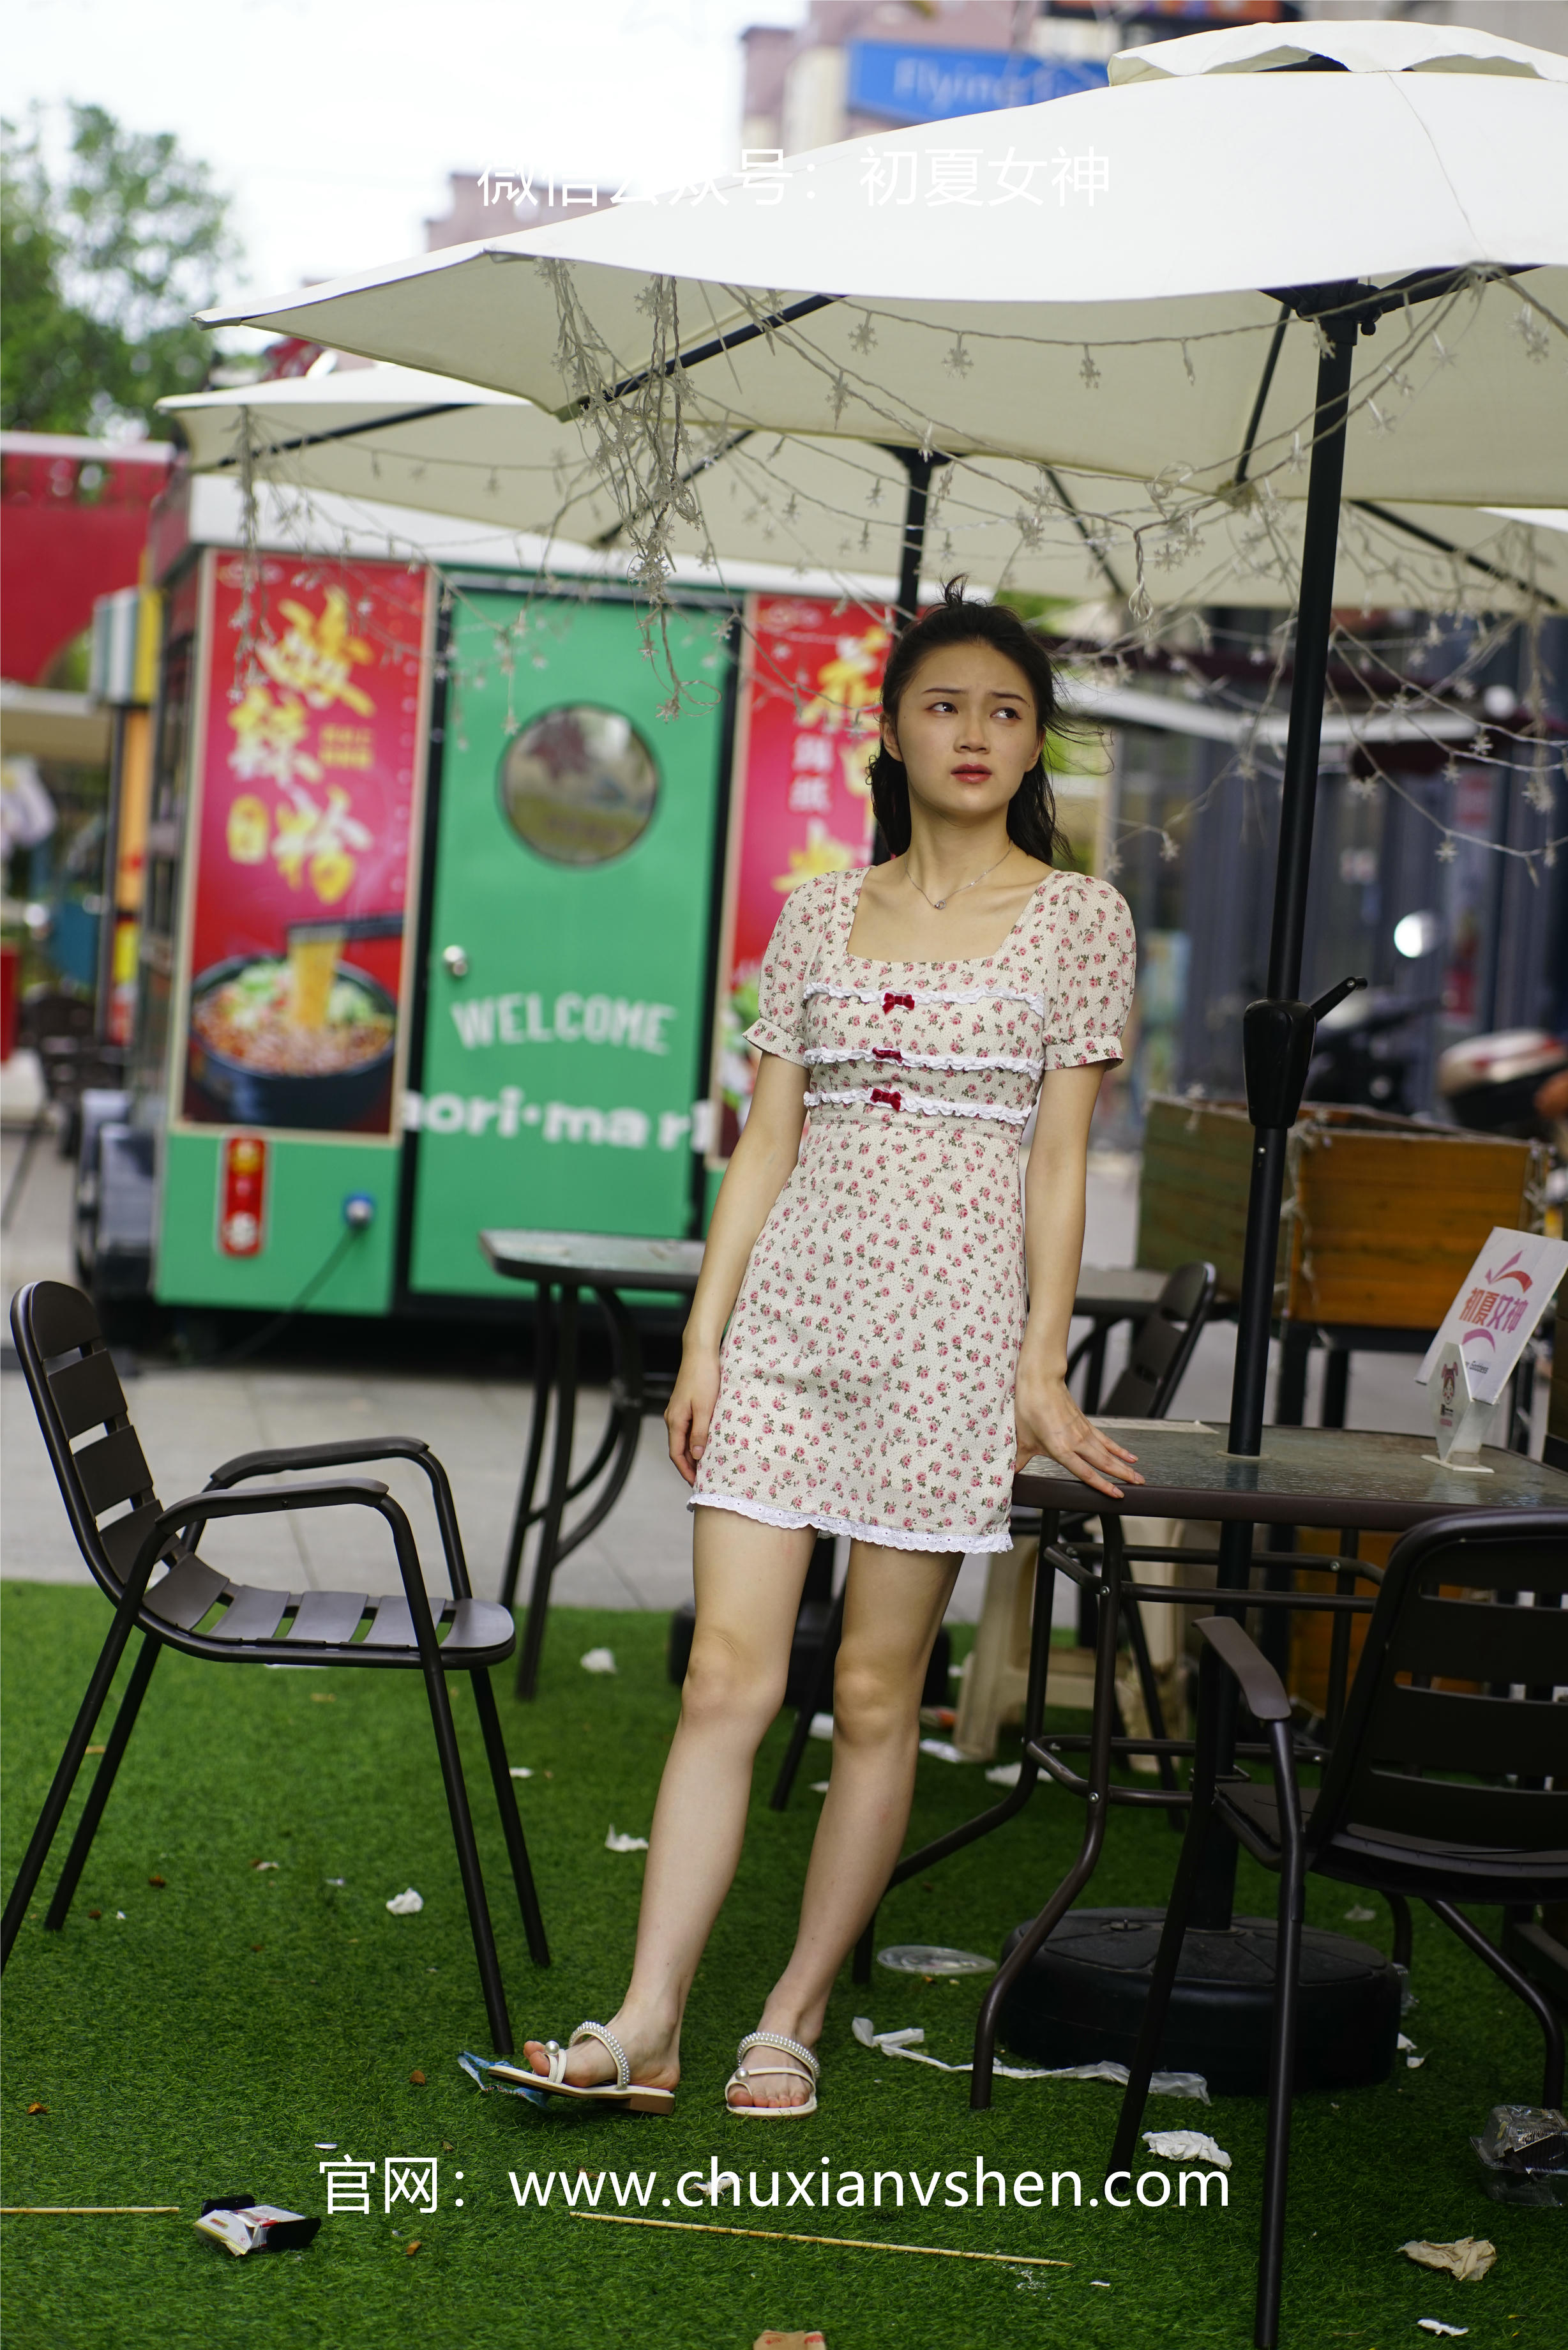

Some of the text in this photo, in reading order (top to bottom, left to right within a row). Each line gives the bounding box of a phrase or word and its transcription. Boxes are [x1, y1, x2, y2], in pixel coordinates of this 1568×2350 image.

[450, 991, 677, 1055] WELCOME
[1459, 1287, 1529, 1334] 初夏女神
